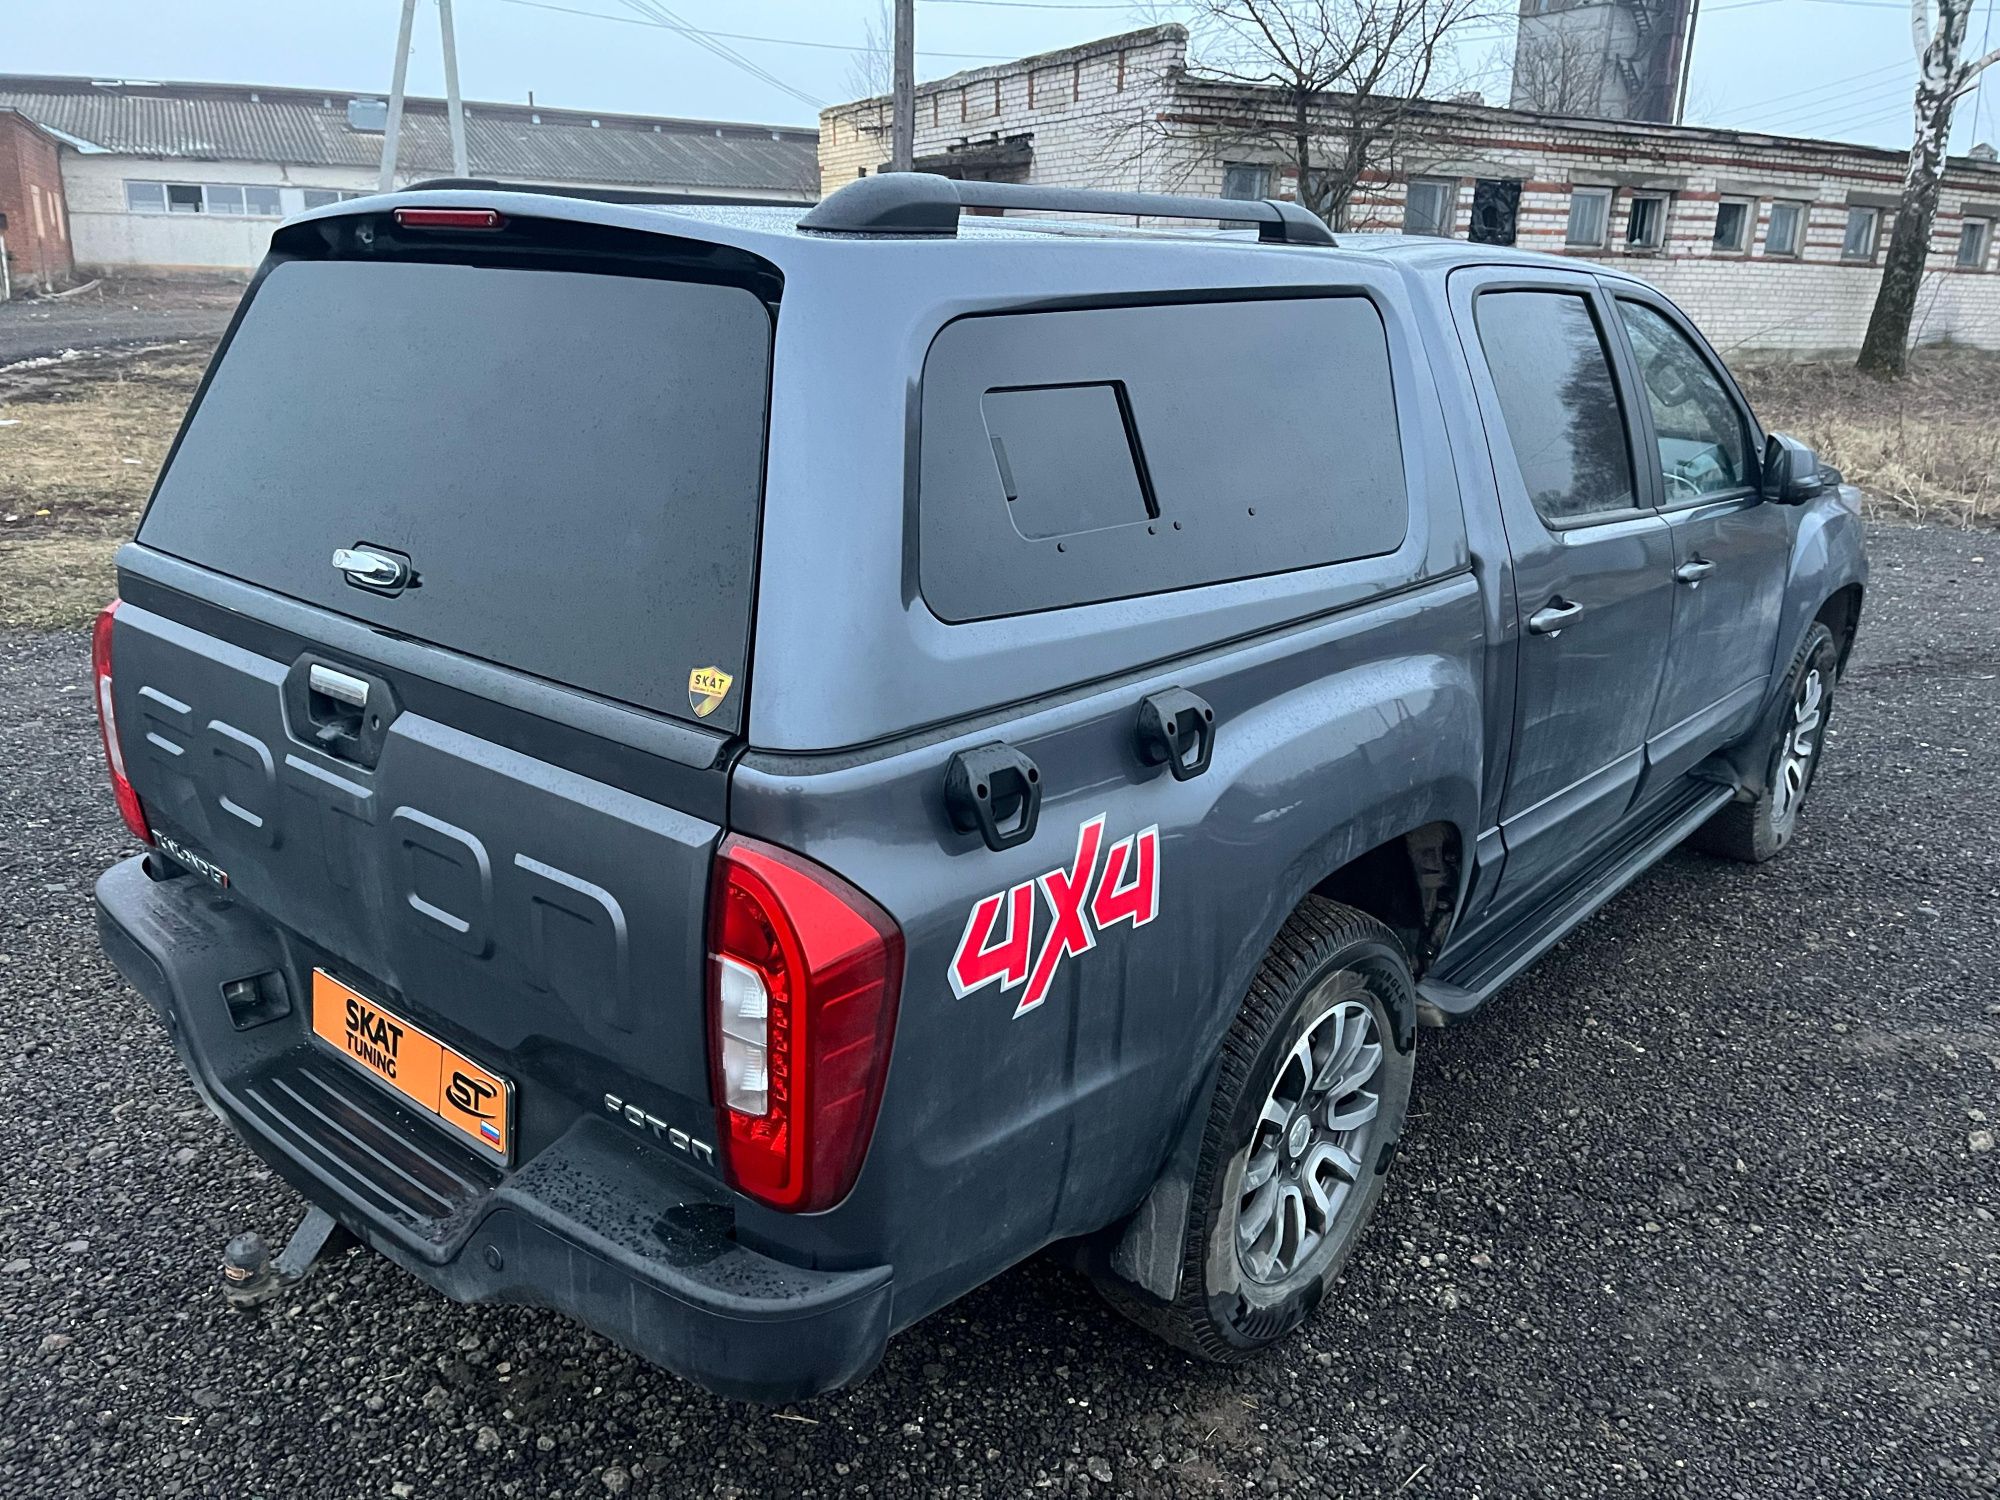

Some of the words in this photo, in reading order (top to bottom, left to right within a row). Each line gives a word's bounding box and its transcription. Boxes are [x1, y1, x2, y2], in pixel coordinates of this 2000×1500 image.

[694, 674, 725, 690] SKAT
[138, 685, 632, 1035] FOTON
[346, 998, 403, 1058] SKAT
[346, 1030, 397, 1079] TUNING
[604, 1093, 714, 1167] FOTON
